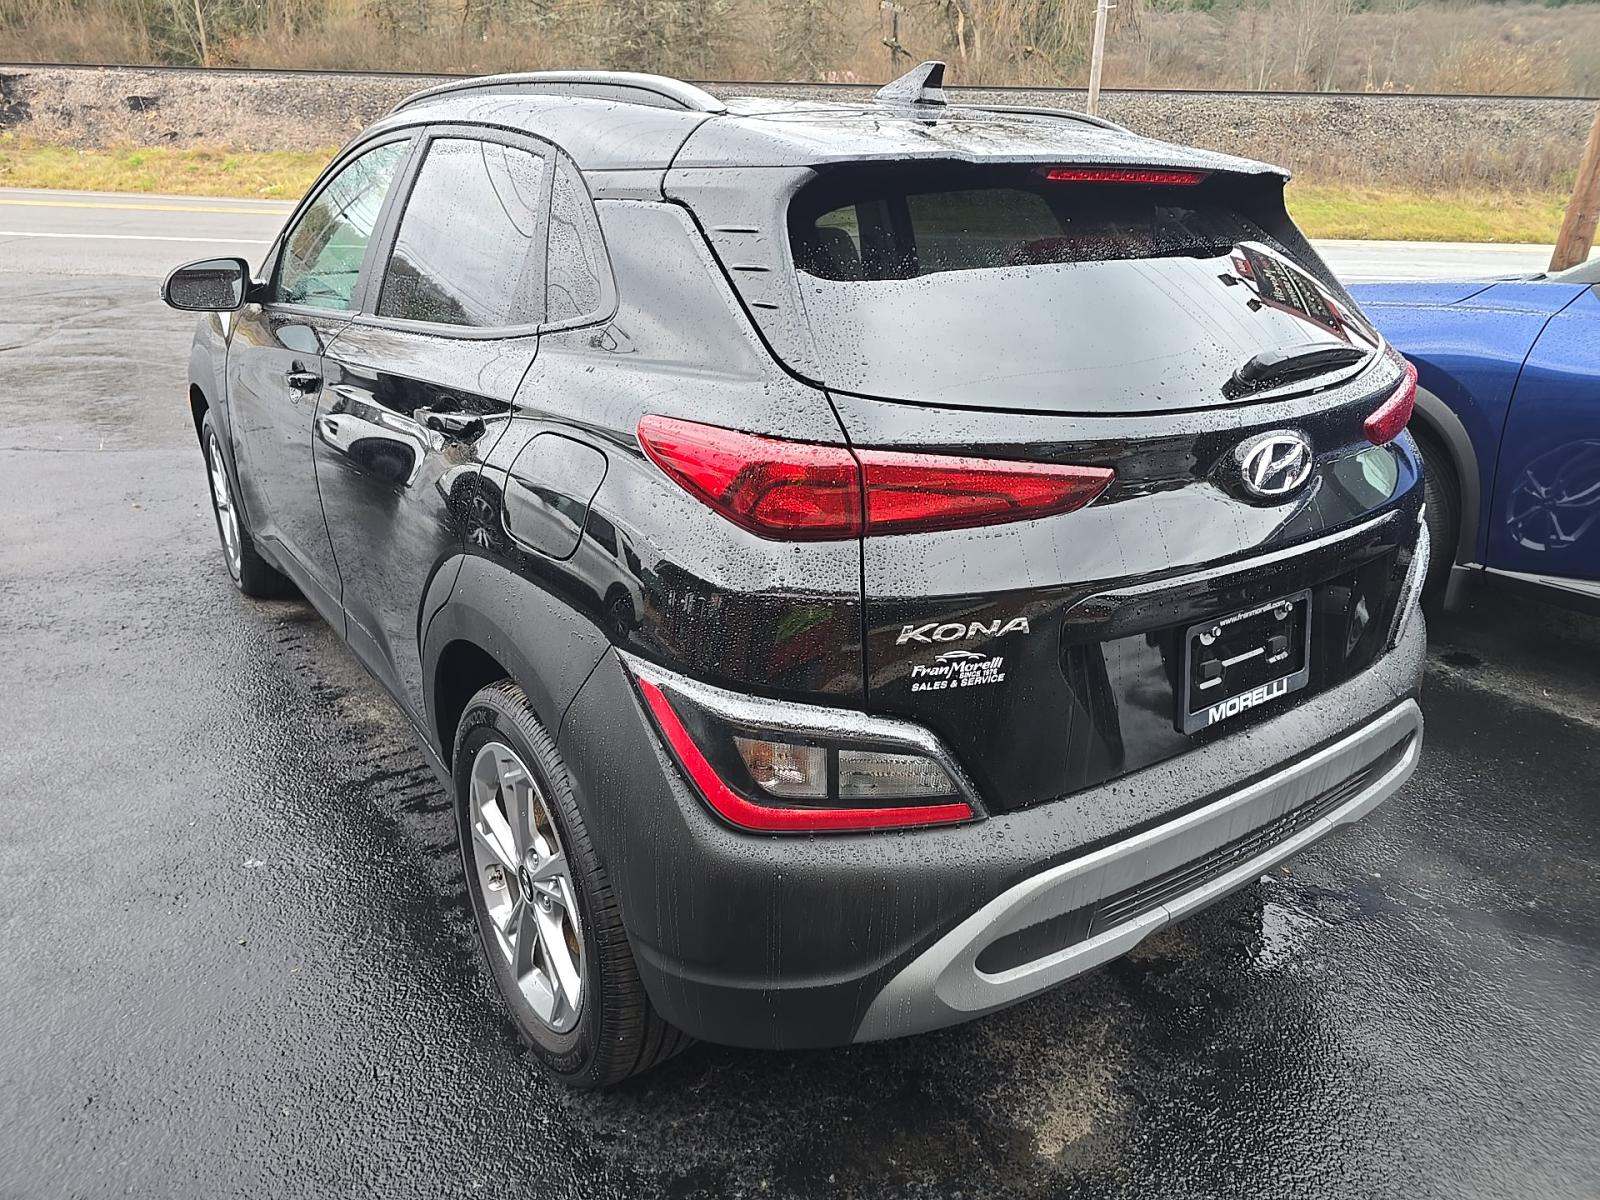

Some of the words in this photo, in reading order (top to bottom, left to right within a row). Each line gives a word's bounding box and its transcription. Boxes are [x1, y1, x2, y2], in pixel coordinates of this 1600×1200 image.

[896, 617, 1030, 645] KONA
[911, 680, 949, 692] SALES
[950, 680, 959, 689] &
[960, 673, 1006, 687] SERVICE
[1208, 678, 1288, 726] MORELLI
